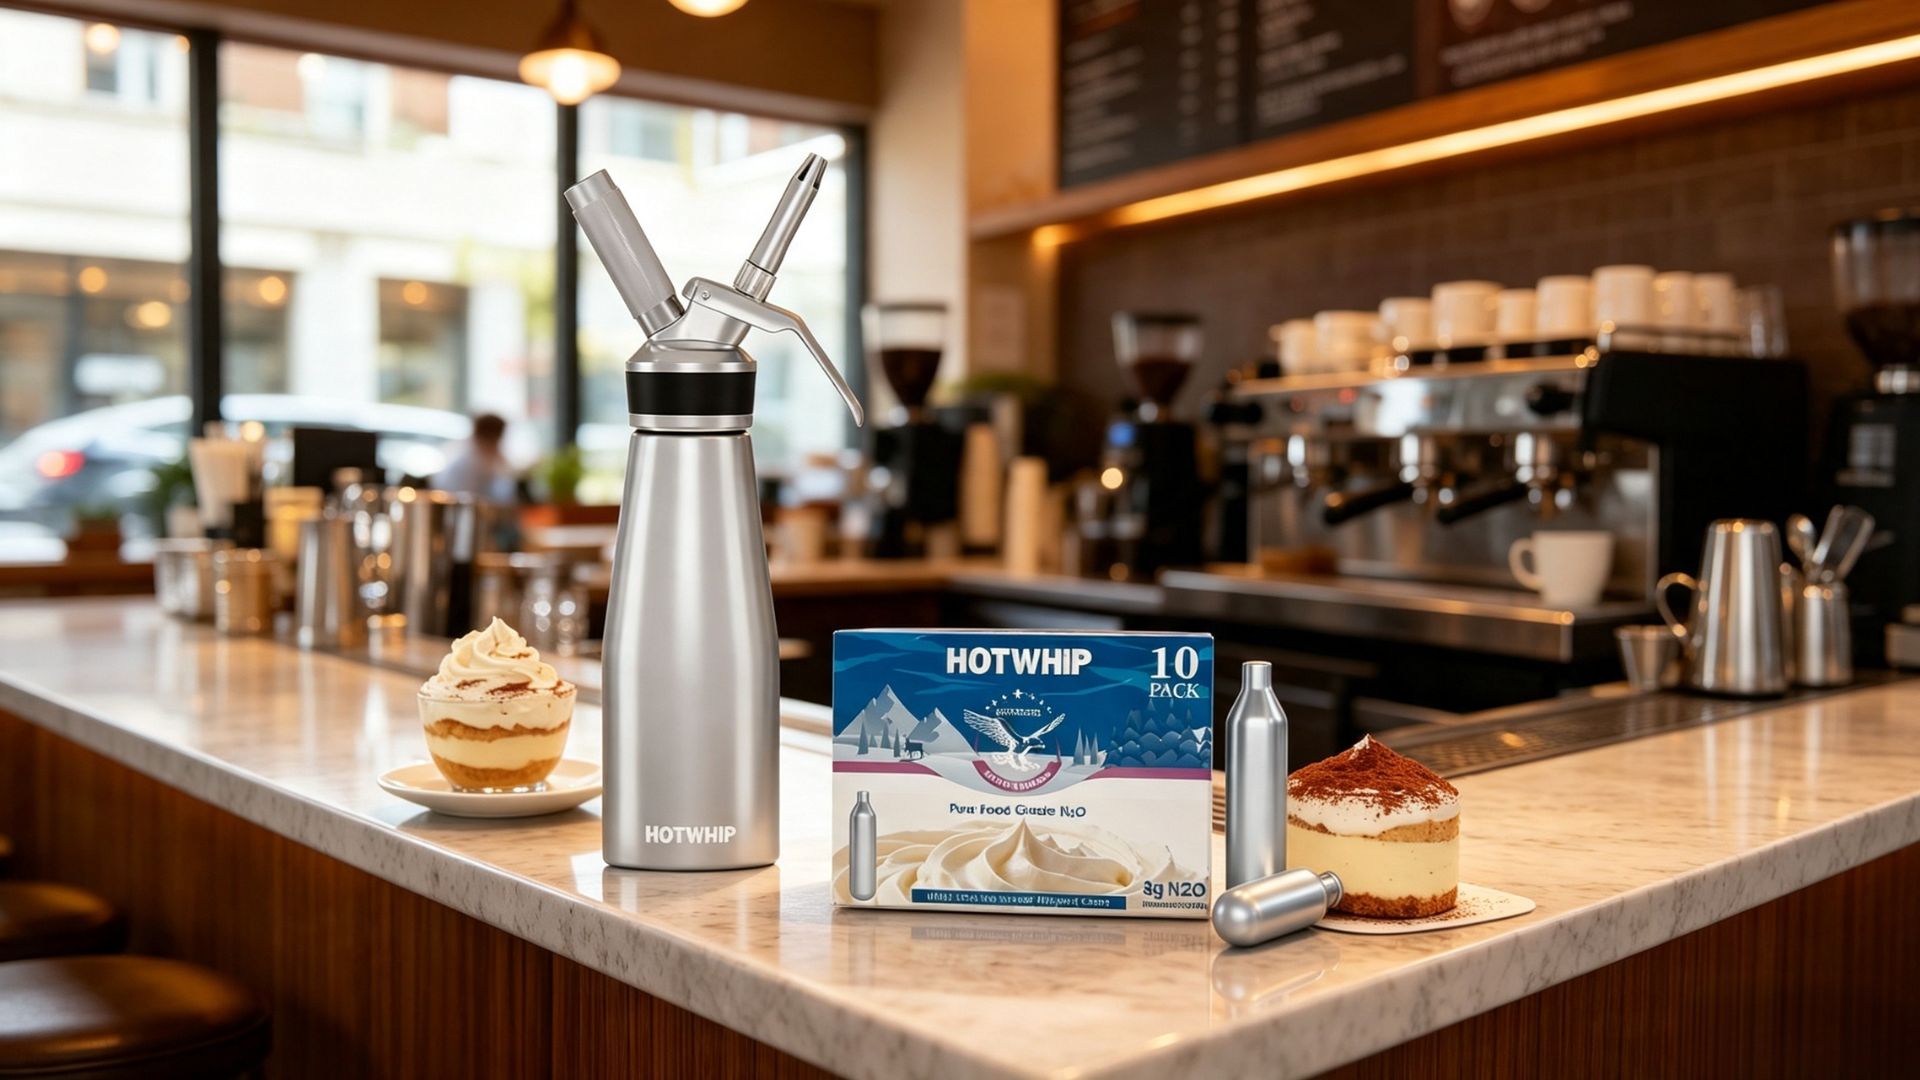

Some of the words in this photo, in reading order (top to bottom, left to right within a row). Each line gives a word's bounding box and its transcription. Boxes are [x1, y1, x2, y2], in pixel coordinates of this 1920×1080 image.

[946, 646, 1093, 677] HOTWHIP
[1150, 645, 1199, 679] 10
[1148, 682, 1200, 699] PACK
[980, 804, 1011, 816] Food
[645, 825, 737, 844] HOTWHIP
[1168, 881, 1206, 898] N2O
